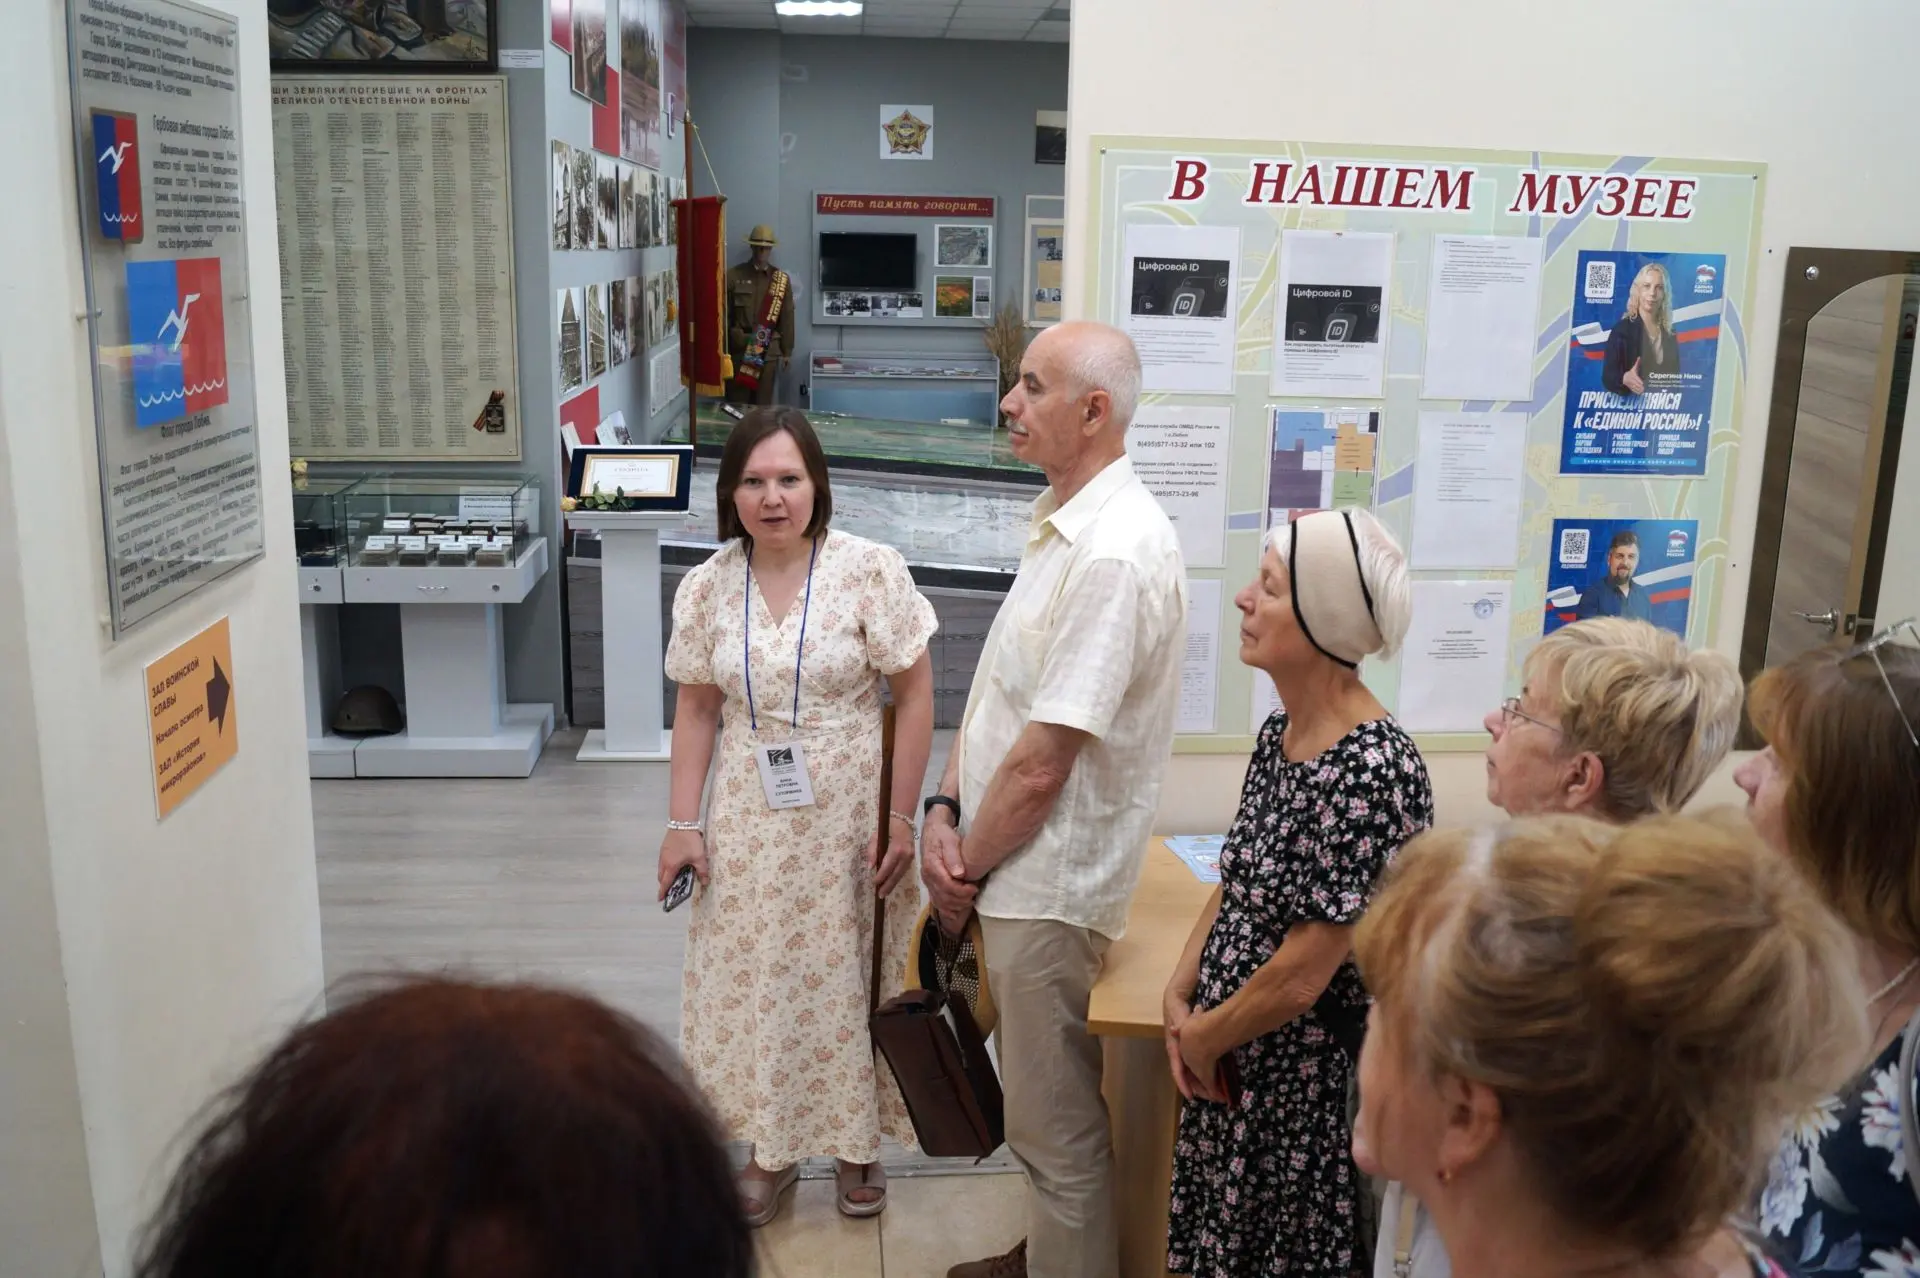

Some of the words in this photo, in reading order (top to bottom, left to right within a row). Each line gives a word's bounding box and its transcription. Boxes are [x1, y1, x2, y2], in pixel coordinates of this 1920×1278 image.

[273, 96, 325, 104] ВЕЛИКОЙ
[330, 96, 426, 104] ОТЕЧЕСТВЕННОЙ
[431, 96, 470, 104] ВОЙНЫ
[1168, 160, 1207, 200] В
[1246, 162, 1475, 210] НАШЕМ
[1509, 173, 1696, 219] МУЗЕЕ
[822, 196, 864, 211] Пусть
[869, 200, 919, 210] память
[1138, 261, 1188, 272] Цифровой
[1189, 262, 1200, 272] ID
[1293, 288, 1341, 298] Цифровой
[1342, 289, 1352, 298] ID
[1179, 300, 1191, 310] ID
[1331, 326, 1343, 336] ID
[1578, 389, 1682, 410] ПРИСОЕДИНЯЙСЯ
[1573, 412, 1584, 429] К
[1584, 410, 1643, 430] «ЕДИНОЙ
[1643, 412, 1703, 430] РОССИИ»!
[1149, 490, 1199, 498] (495)573-23-96
[151, 681, 165, 699] ЗАЛ
[166, 656, 200, 689] ВОИНСКОЙ
[153, 692, 177, 717] СЛАВЫ
[156, 722, 179, 745] Начало
[179, 703, 204, 728] осмотра
[159, 757, 172, 775] ЗАЛ
